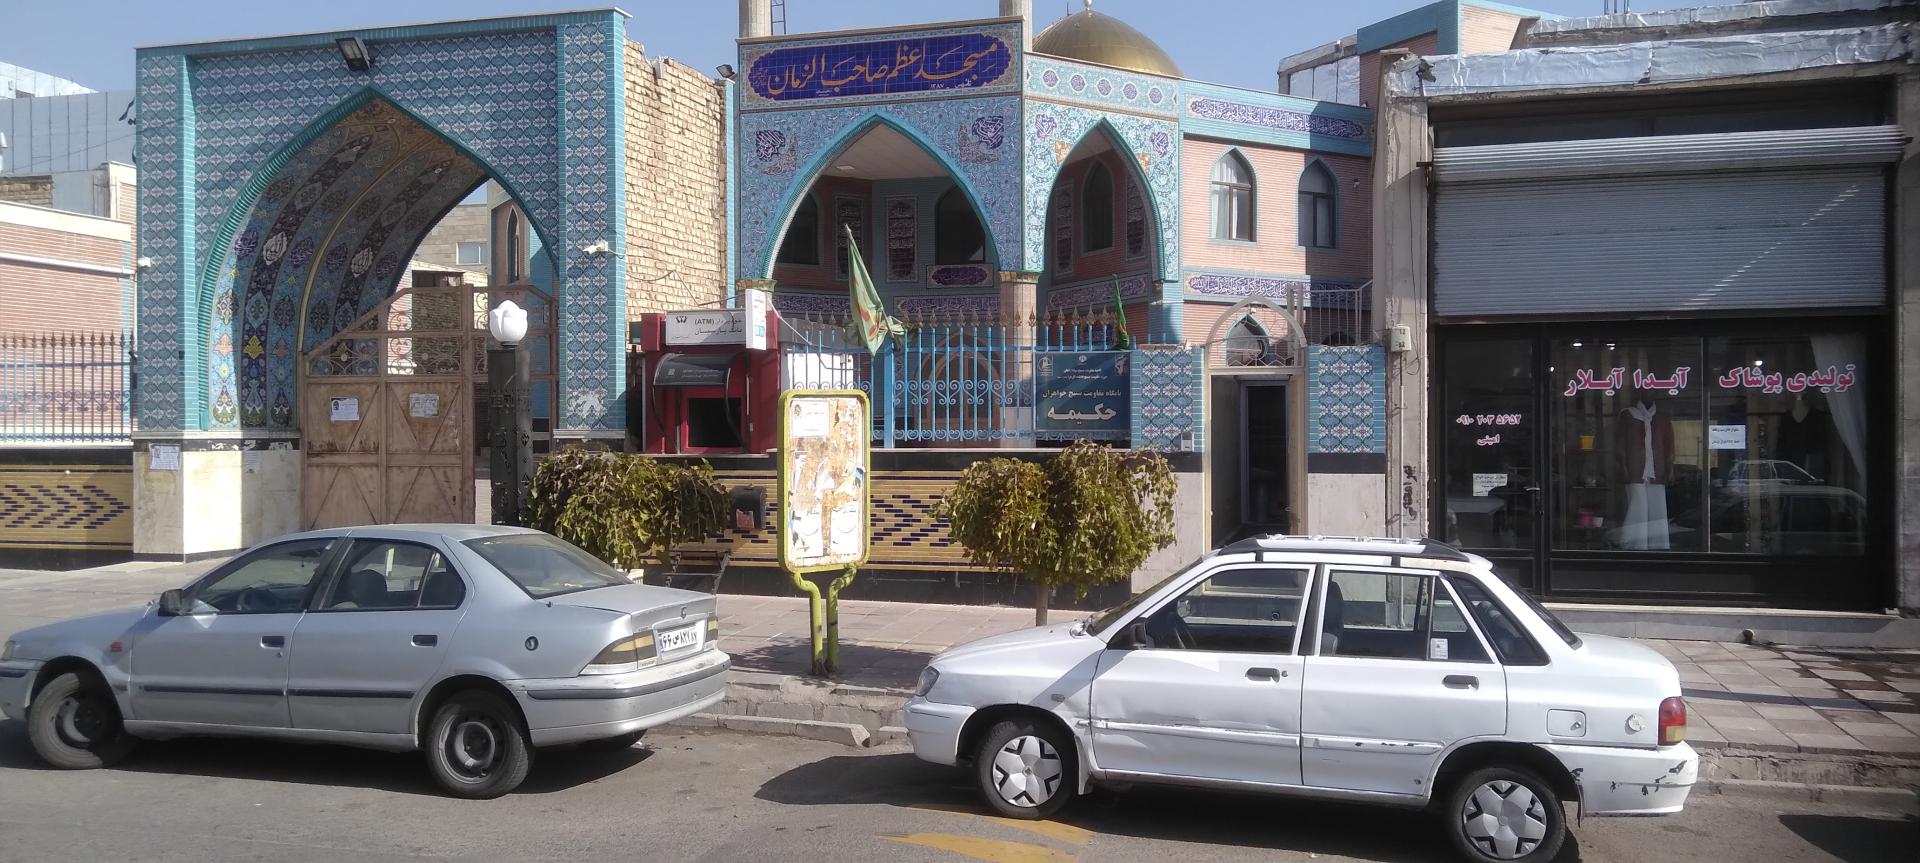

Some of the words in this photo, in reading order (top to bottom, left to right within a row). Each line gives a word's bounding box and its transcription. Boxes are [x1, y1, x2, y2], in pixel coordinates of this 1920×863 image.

[767, 52, 827, 95] الزمان
[823, 56, 888, 92] صاحب
[884, 39, 926, 93] اعظم
[914, 42, 999, 82] مسجد
[1042, 389, 1067, 398] خواهران
[1564, 367, 1626, 397] آیلار
[1633, 367, 1691, 396] آیدا
[1719, 367, 1783, 394] پوشاک
[1786, 365, 1856, 394] تولیدی
[1047, 403, 1117, 425] حکیمه
[1477, 433, 1500, 446] امینی
